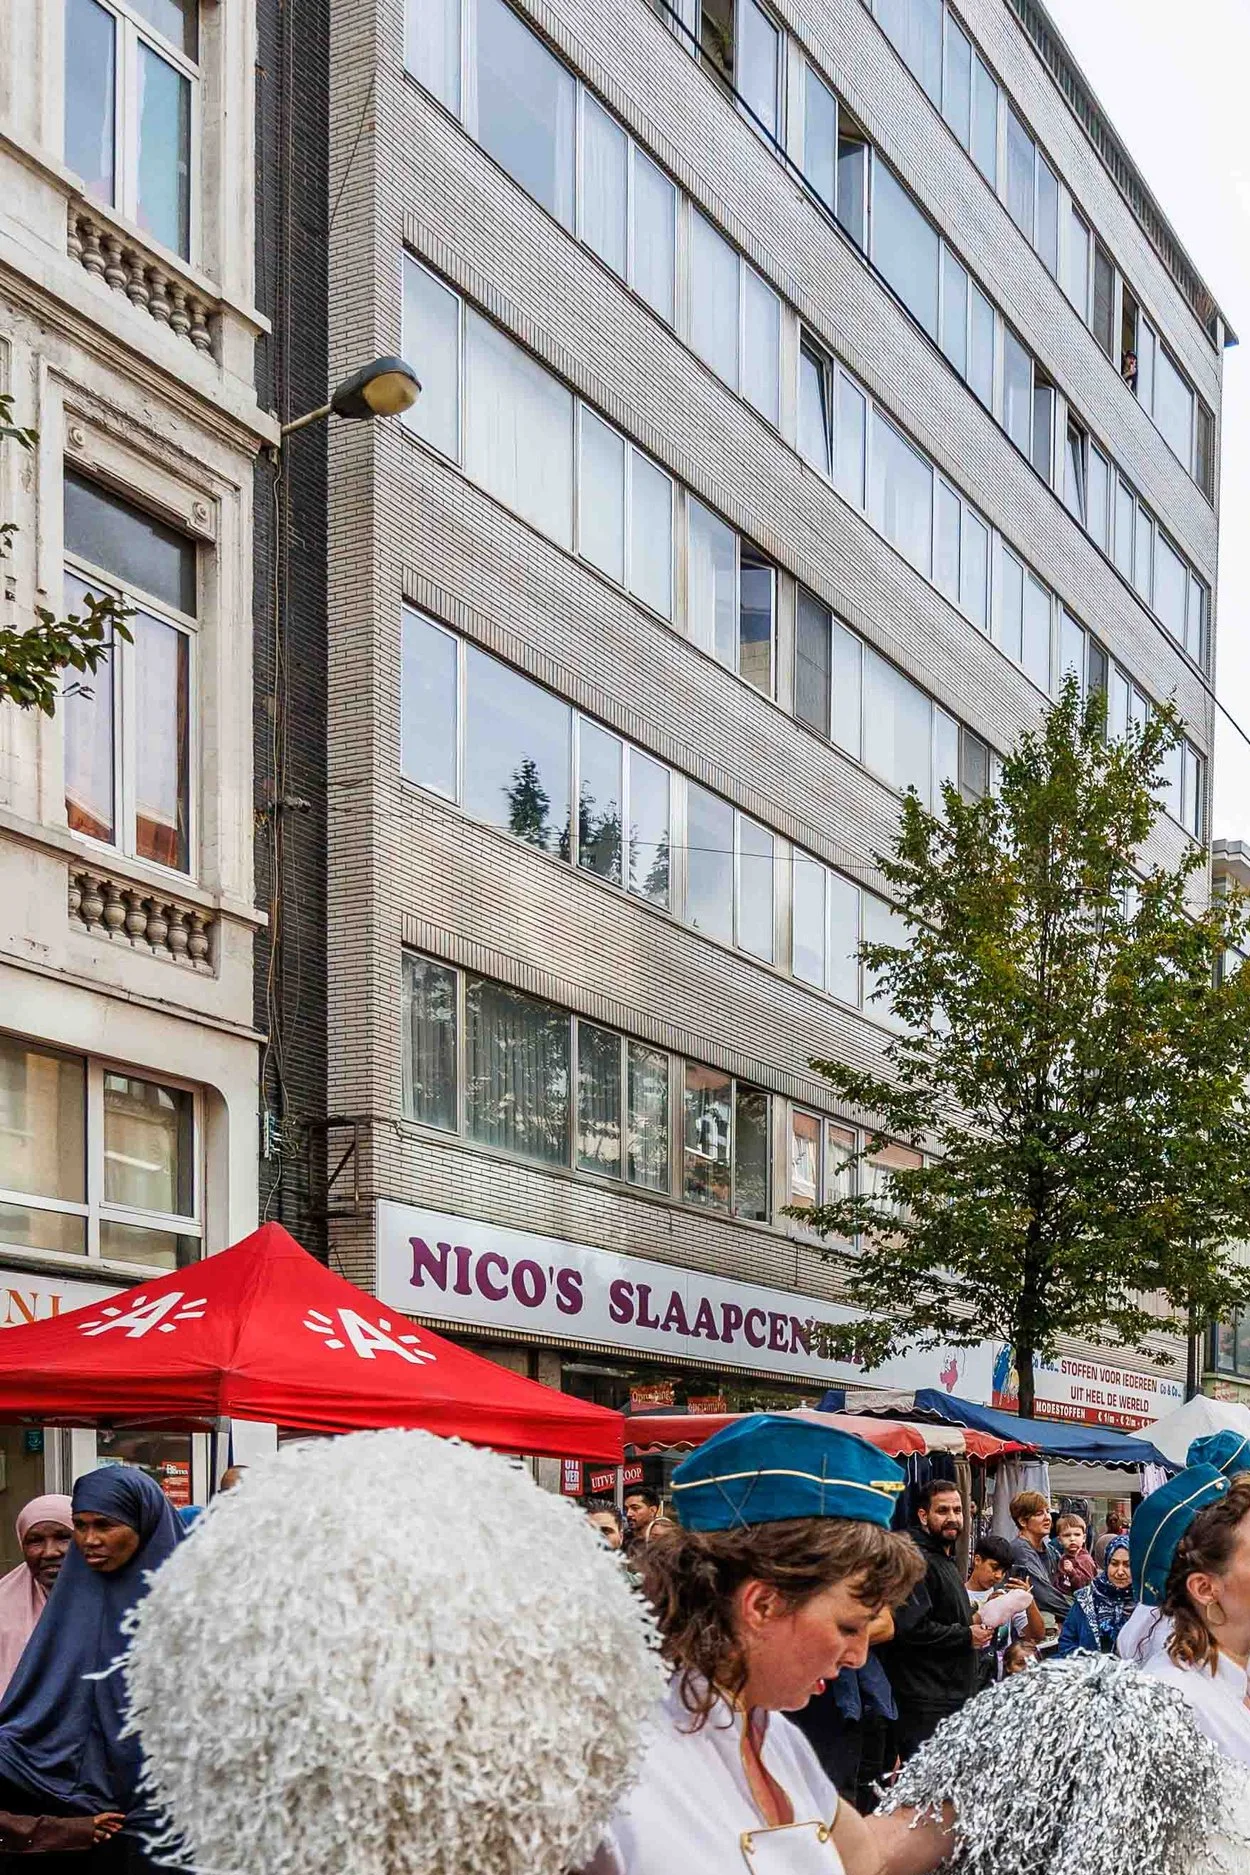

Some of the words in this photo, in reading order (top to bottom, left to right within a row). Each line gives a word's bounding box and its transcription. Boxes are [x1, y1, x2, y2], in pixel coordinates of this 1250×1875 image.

[0, 1286, 63, 1325] NI
[409, 1237, 583, 1315] NICO'S
[608, 1280, 866, 1366] SLAAPCENT
[337, 1308, 426, 1364] A
[1061, 1359, 1097, 1381] STOFFEN
[1100, 1368, 1120, 1386] VOOR
[1123, 1373, 1158, 1393] IEDEREEN
[1035, 1401, 1086, 1419] MODESTOFFEN
[1070, 1386, 1084, 1401] UIT
[1086, 1388, 1105, 1405] HEEL
[1108, 1393, 1117, 1407] DE
[1119, 1395, 1149, 1413] WERELD
[592, 1467, 642, 1488] UITVEOOP
